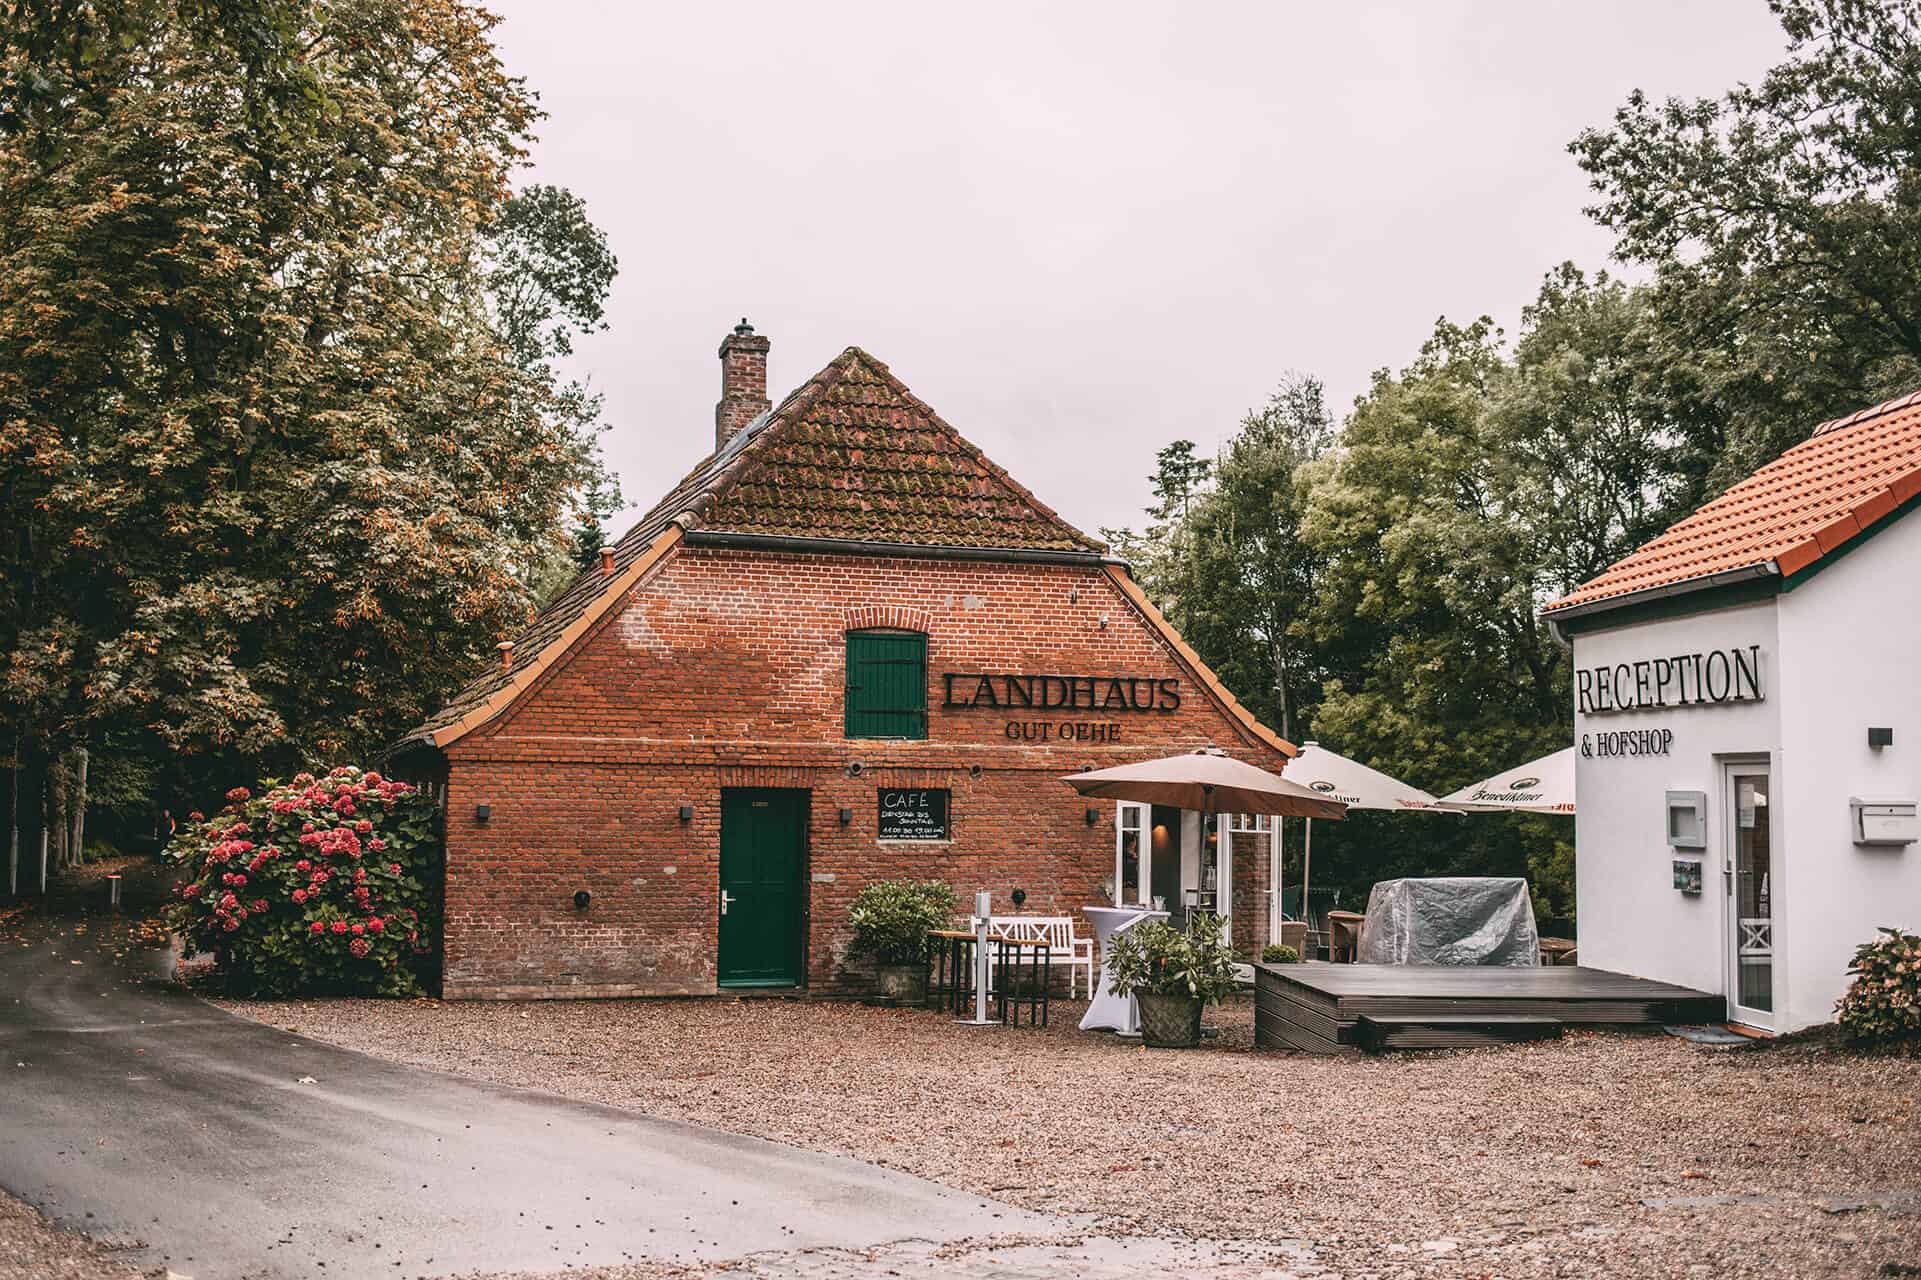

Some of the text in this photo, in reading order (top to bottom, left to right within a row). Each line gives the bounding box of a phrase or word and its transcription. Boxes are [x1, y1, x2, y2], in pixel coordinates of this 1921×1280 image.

[942, 673, 1181, 713] LANDHAUS
[1576, 645, 1765, 714] RECEPTION
[1005, 722, 1121, 741] GUT OEHE
[1581, 728, 1672, 757] & HOFSHOP
[1472, 789, 1543, 802] Benediktiner
